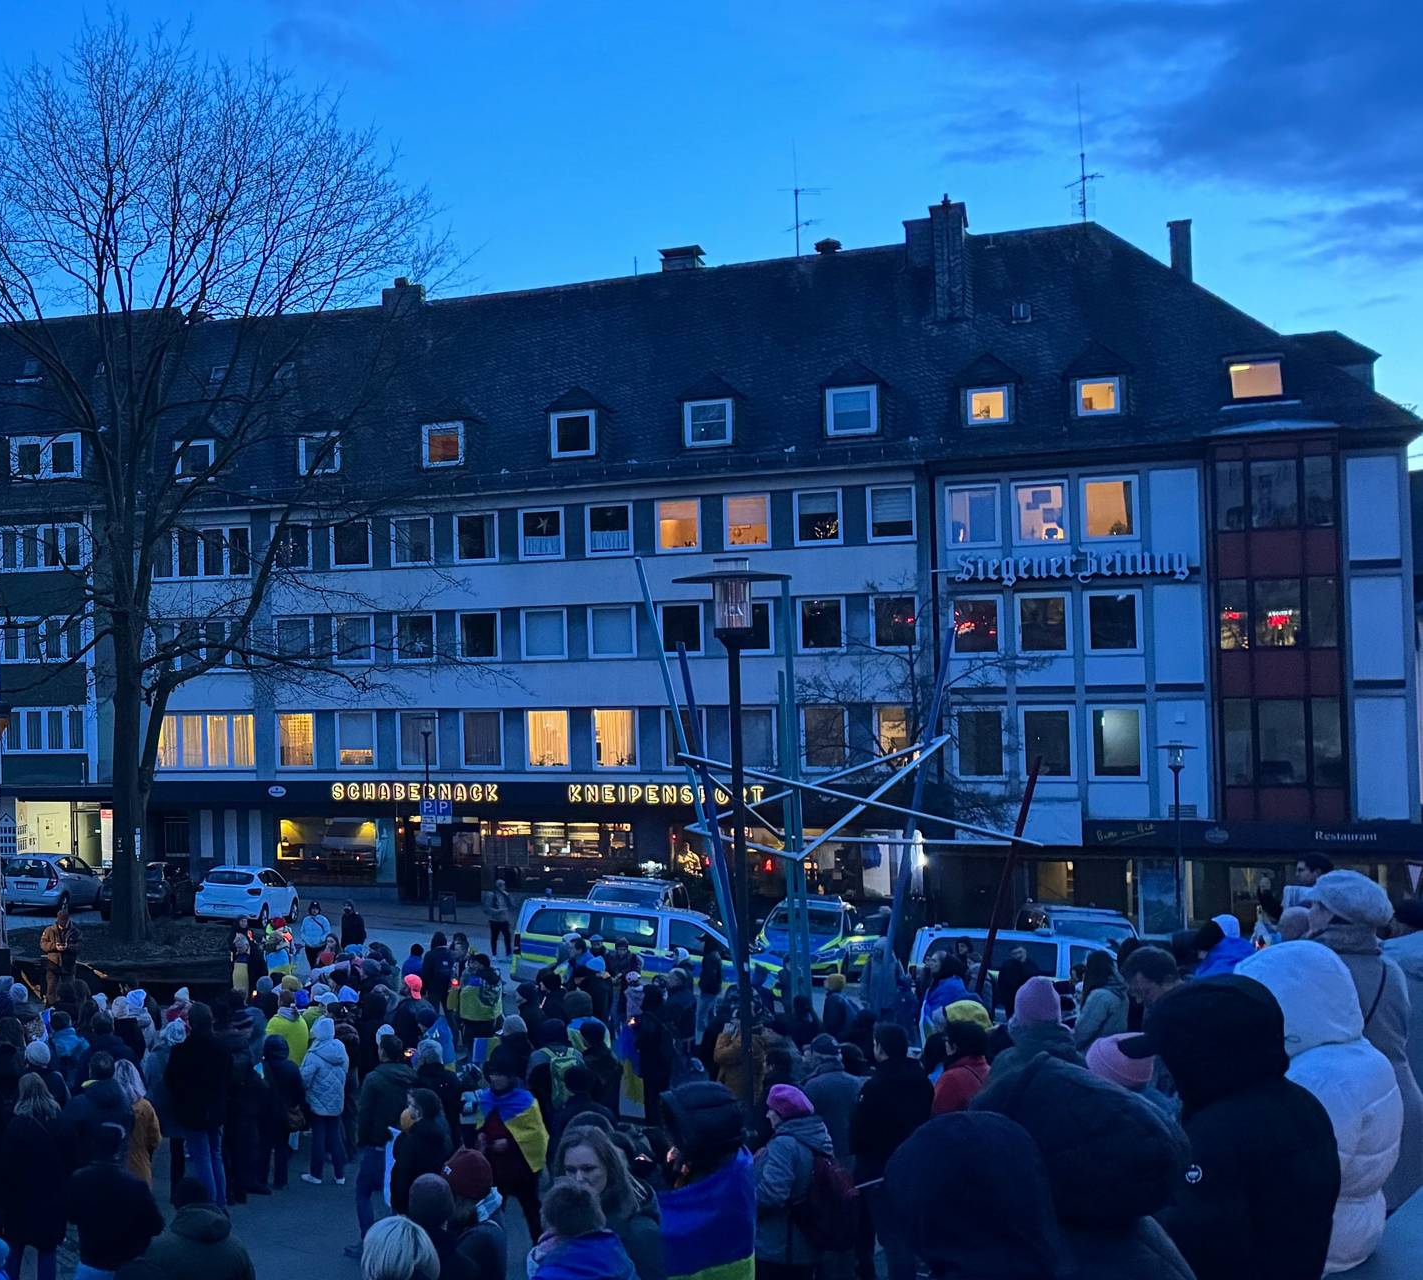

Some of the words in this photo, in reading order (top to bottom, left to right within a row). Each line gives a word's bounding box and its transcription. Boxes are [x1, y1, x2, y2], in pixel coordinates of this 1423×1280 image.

[955, 551, 1076, 587] Siegener
[1077, 546, 1190, 583] Zeitung
[331, 782, 499, 802] SCHABERNACK
[568, 784, 764, 805] KNEIPENSOT
[423, 801, 433, 813] P
[439, 801, 448, 814] P
[1315, 830, 1378, 841] Restaurant
